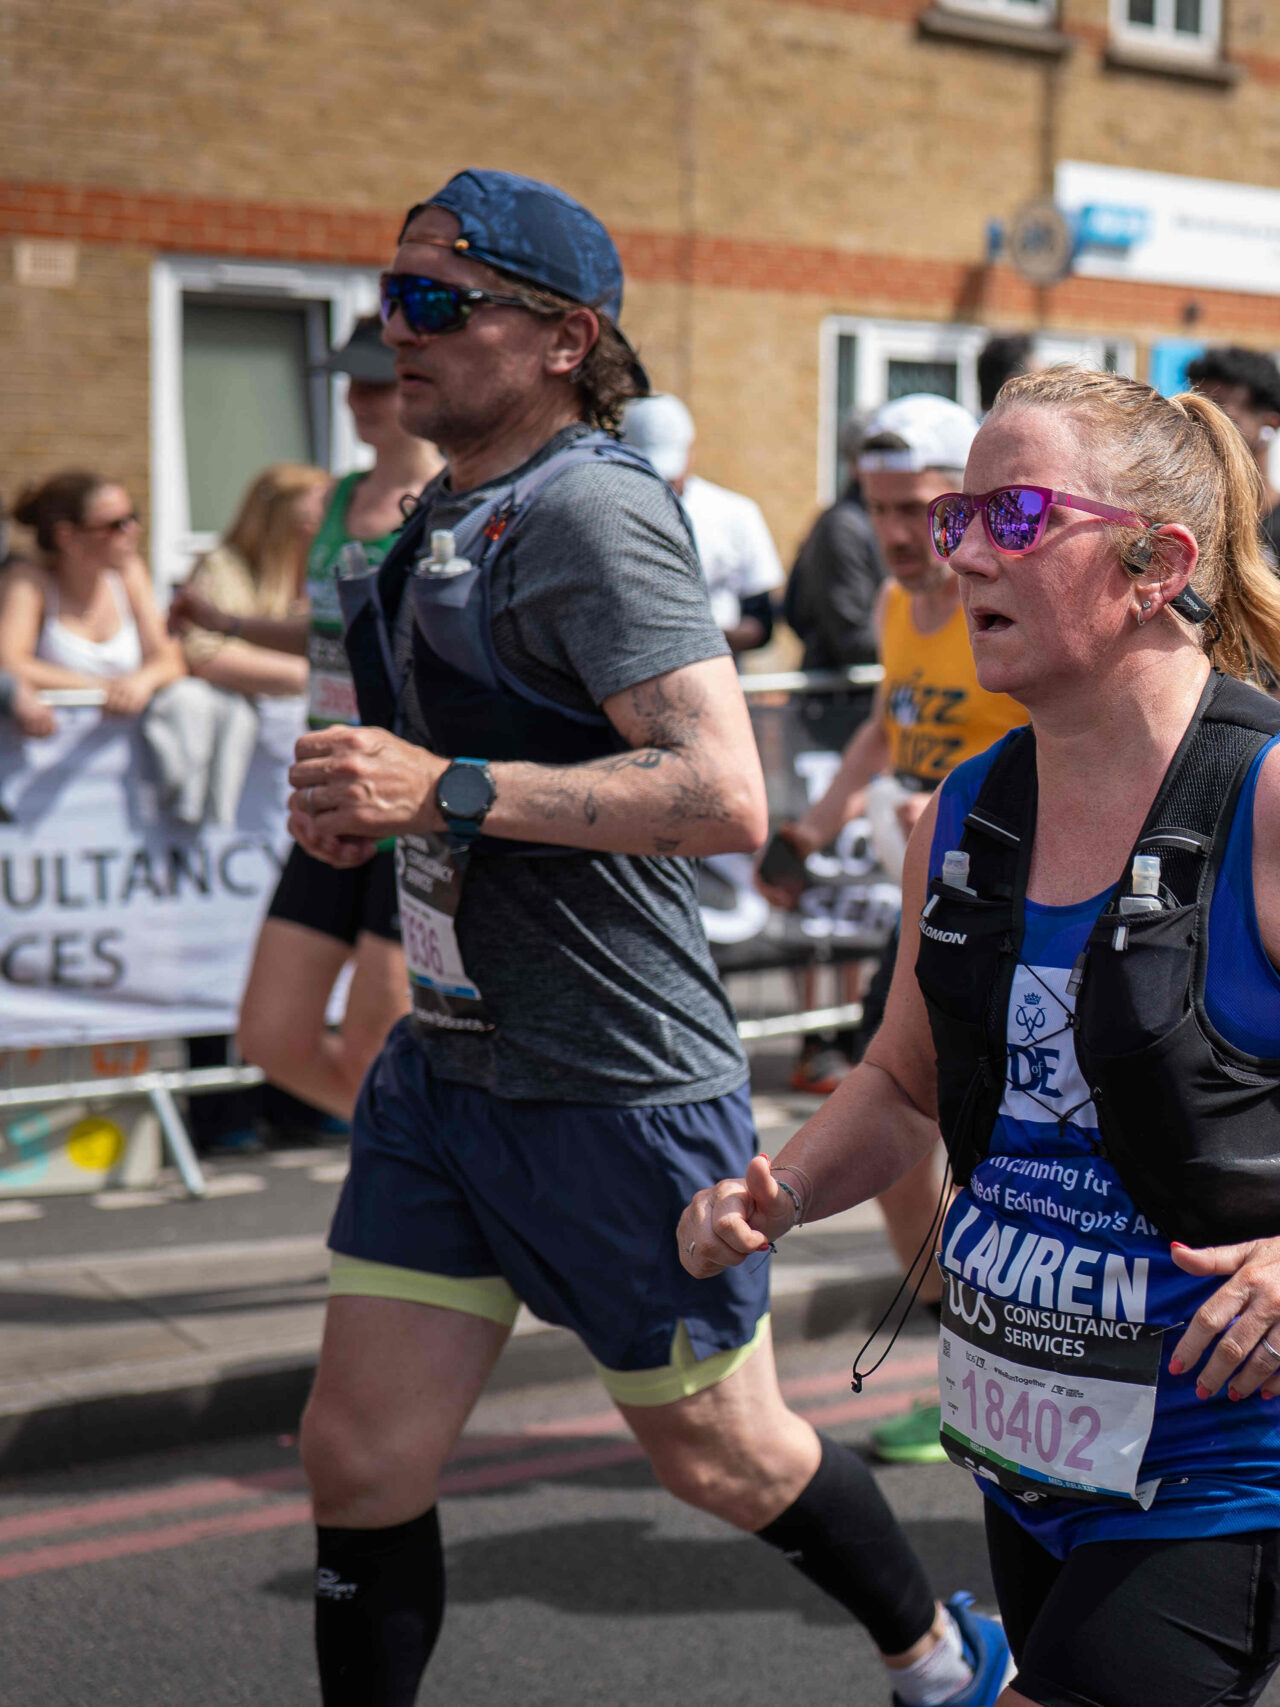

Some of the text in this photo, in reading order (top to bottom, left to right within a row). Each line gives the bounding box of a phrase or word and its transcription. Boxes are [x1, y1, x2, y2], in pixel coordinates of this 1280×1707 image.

[0, 928, 125, 990] CES
[1004, 1187, 1129, 1233] Edinburgh's
[944, 1205, 1150, 1324] LAUREN
[1003, 1304, 1143, 1342] CONSULTANCY
[1004, 1326, 1086, 1359] SERVICES
[962, 1369, 1101, 1472] 18402
